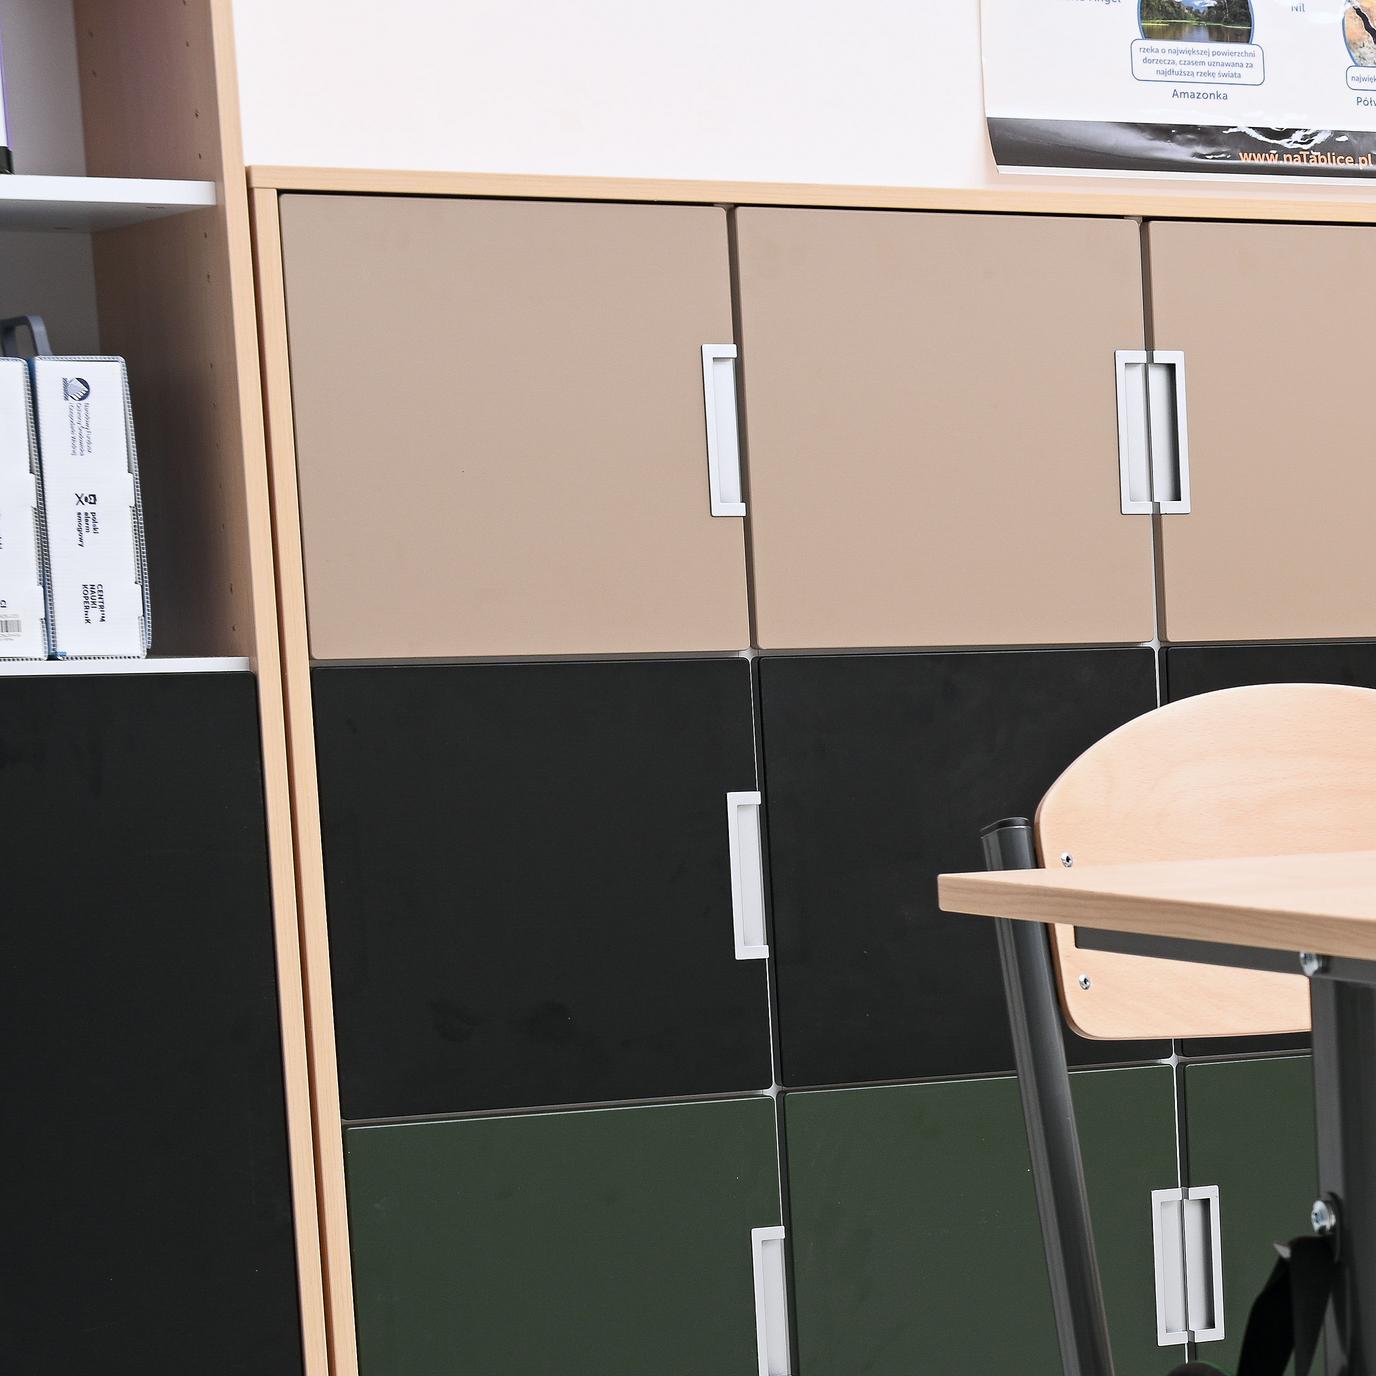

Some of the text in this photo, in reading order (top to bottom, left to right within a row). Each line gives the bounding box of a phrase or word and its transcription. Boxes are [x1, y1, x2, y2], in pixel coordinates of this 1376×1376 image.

[1139, 46, 1159, 55] rzeka
[1167, 46, 1210, 57] największej
[1212, 48, 1256, 58] powierzchni
[1142, 57, 1176, 66] dorzecza,
[1179, 59, 1206, 67] czasem
[1156, 67, 1241, 79] najdłuższą rzekę świata
[1172, 88, 1228, 100] Amazonka
[1239, 150, 1373, 169] www.naTablice.pl
[89, 584, 97, 609] NAUKI
